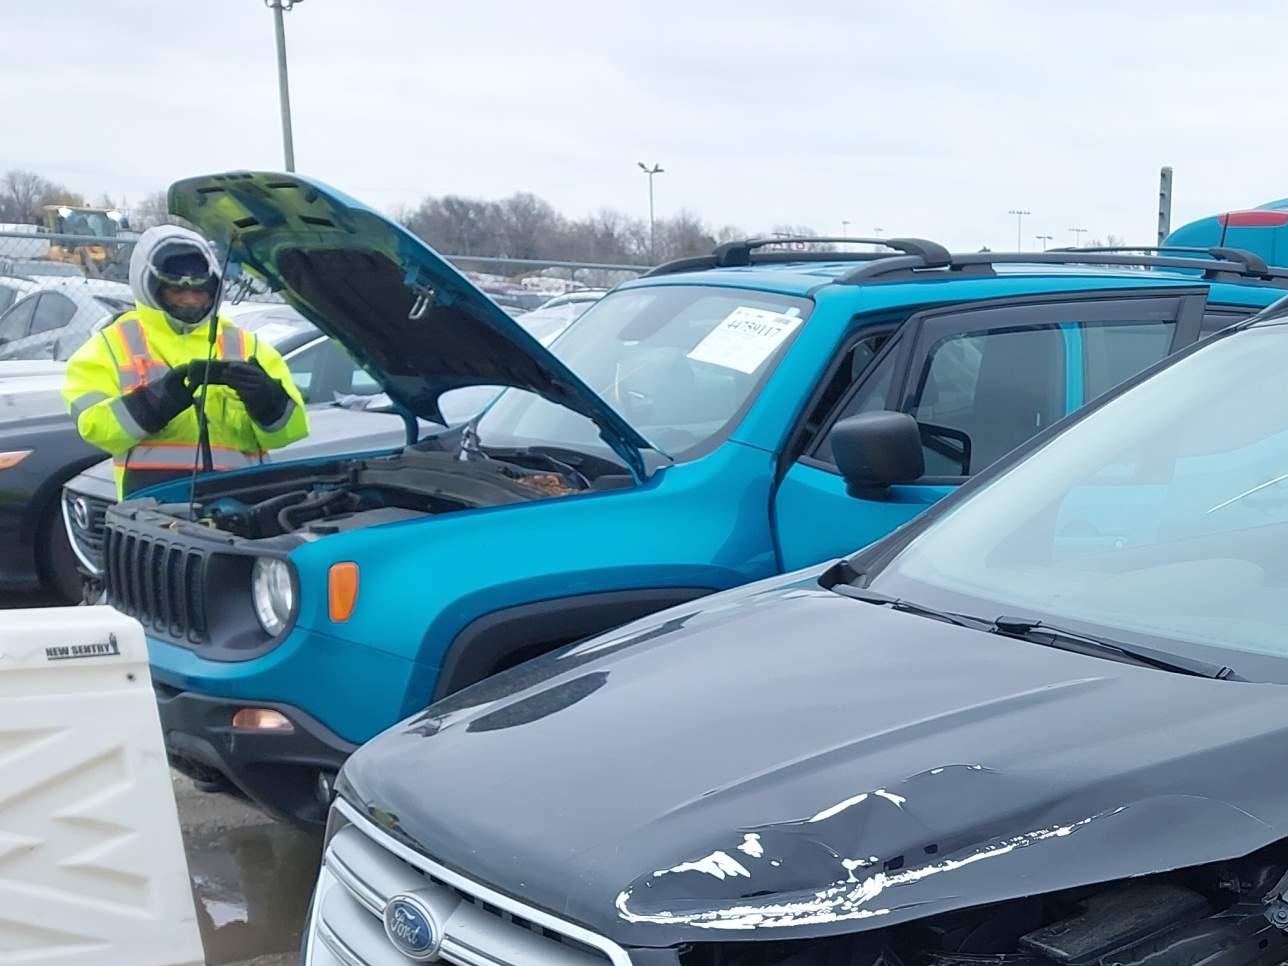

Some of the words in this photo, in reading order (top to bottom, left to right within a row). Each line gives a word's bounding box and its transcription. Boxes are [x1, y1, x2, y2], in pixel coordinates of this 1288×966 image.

[45, 646, 70, 657] NEW
[71, 643, 110, 655] SENTRY
[390, 907, 421, 945] Ford
